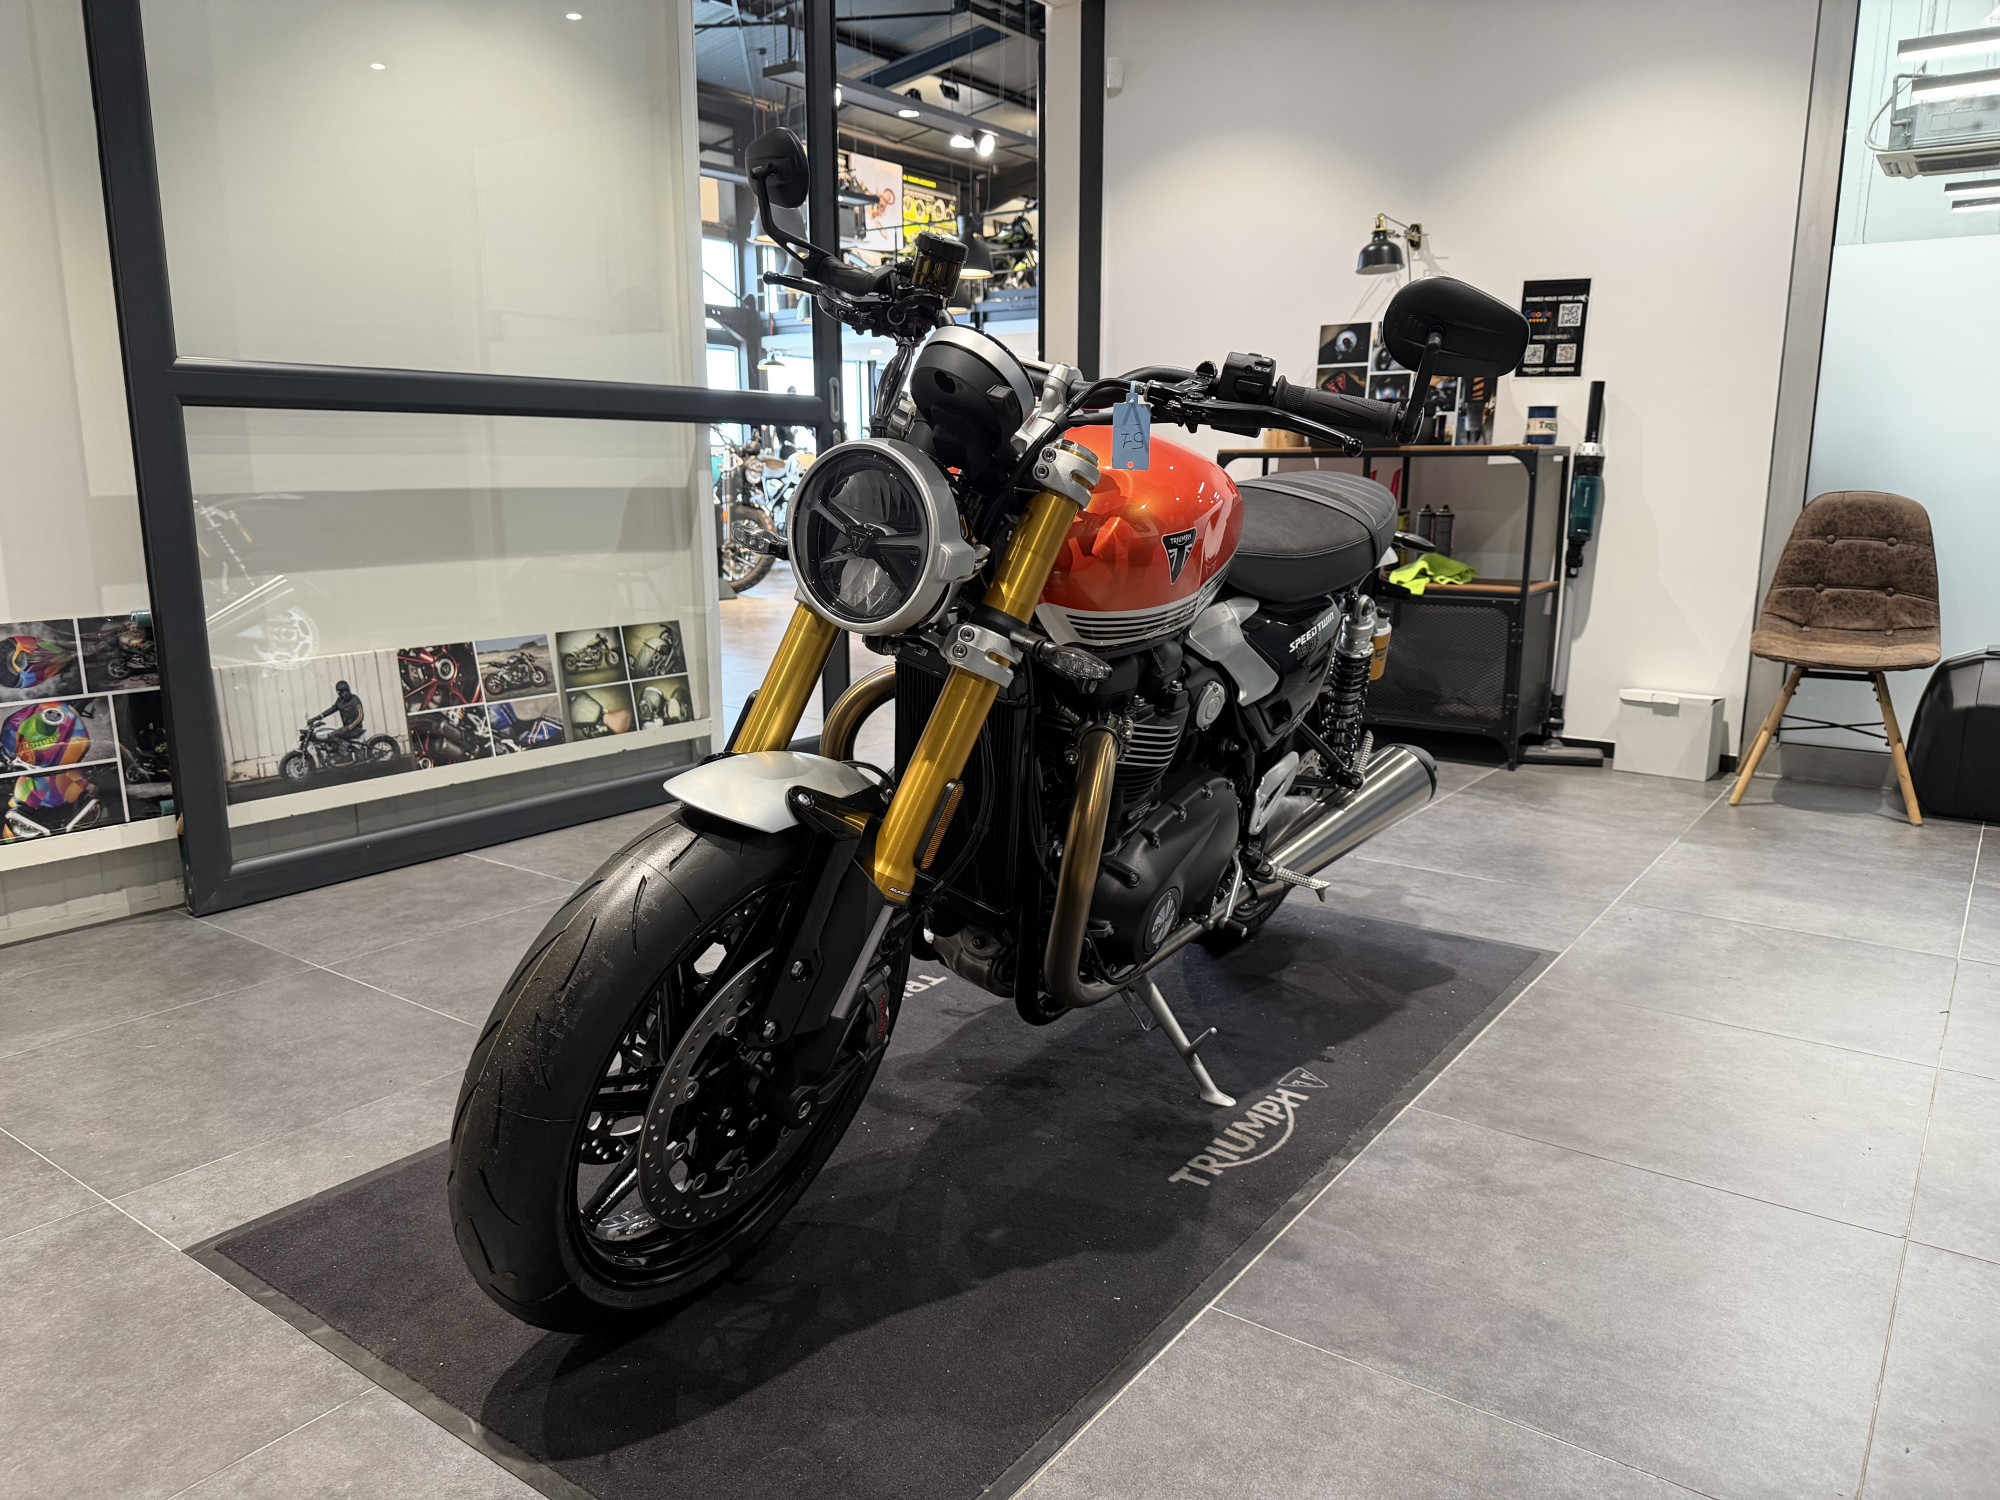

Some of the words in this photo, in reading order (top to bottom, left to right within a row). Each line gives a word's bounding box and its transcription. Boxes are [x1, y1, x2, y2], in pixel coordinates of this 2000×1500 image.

[1170, 533, 1192, 546] TRIUMPH
[1289, 625, 1318, 654] SPEED
[1317, 611, 1334, 631] TWIN
[1167, 1088, 1310, 1187] TRIUMPH
